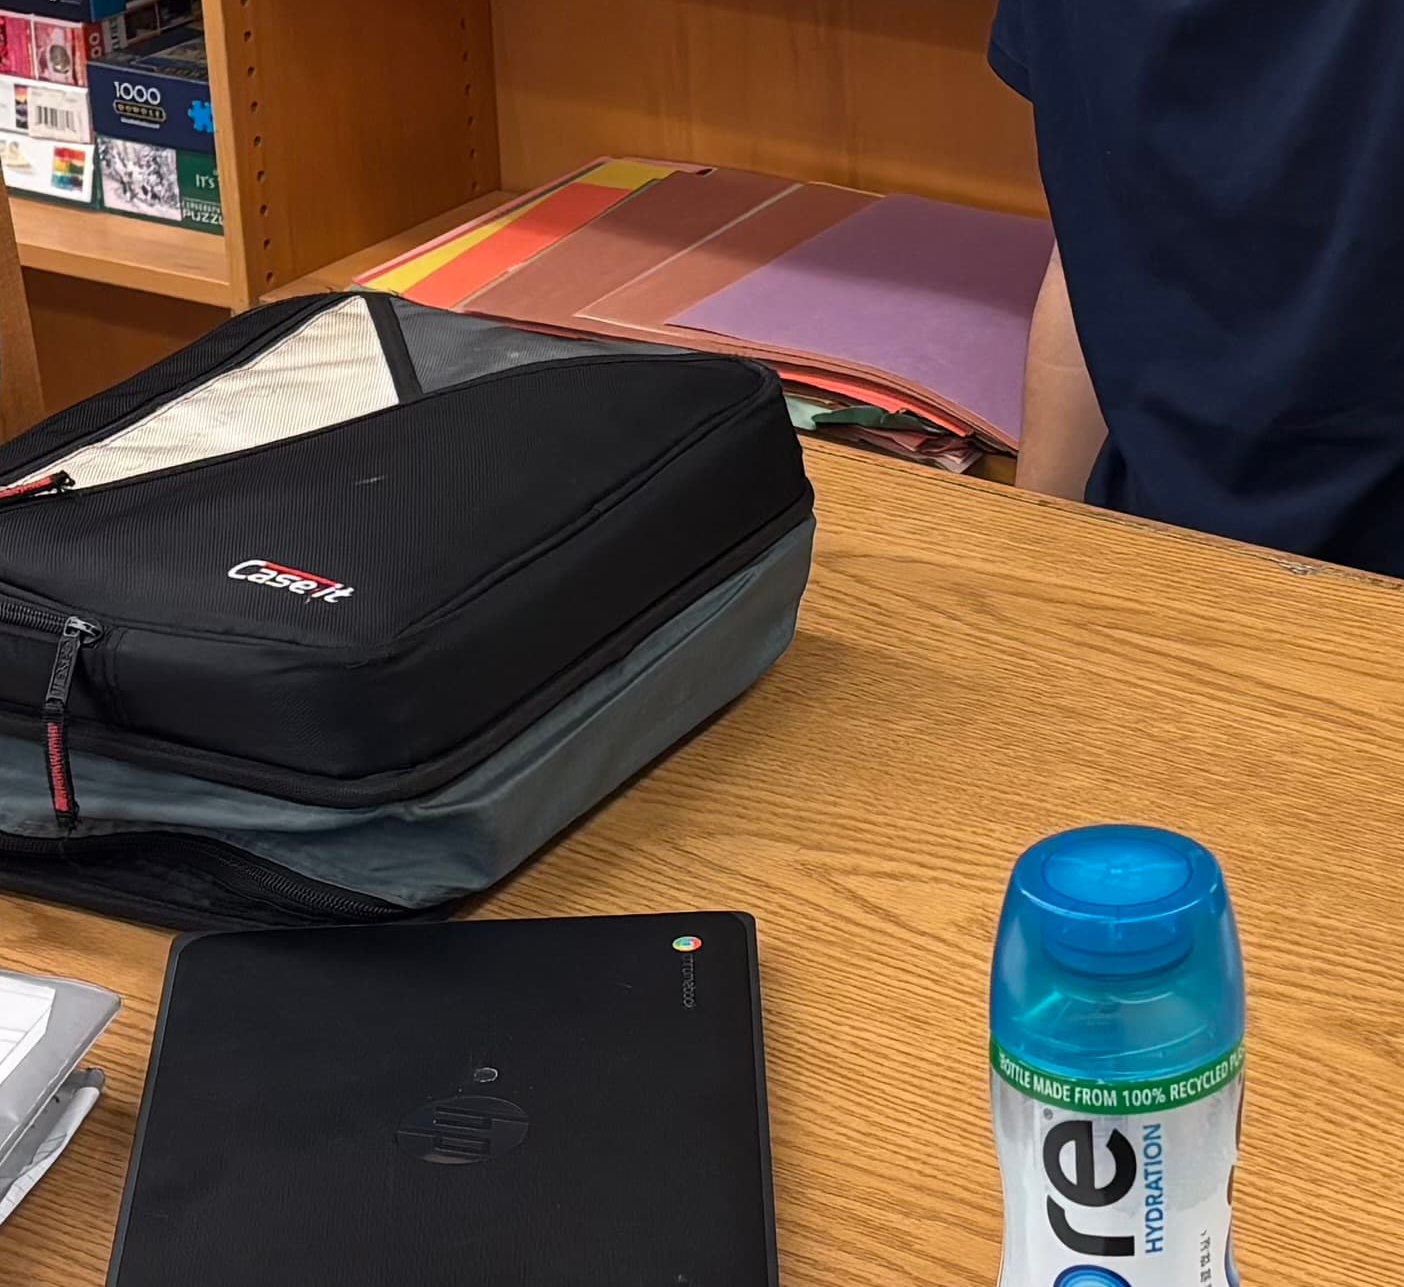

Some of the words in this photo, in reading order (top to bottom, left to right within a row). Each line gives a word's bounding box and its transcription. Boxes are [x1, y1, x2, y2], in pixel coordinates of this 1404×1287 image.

[113, 81, 161, 105] 1000
[1033, 1074, 1071, 1103] MADE
[1074, 1087, 1117, 1107] FROM
[1122, 1086, 1167, 1107] 100%
[1170, 1061, 1229, 1102] RECYCLED
[1142, 1123, 1164, 1255] HYDRATION
